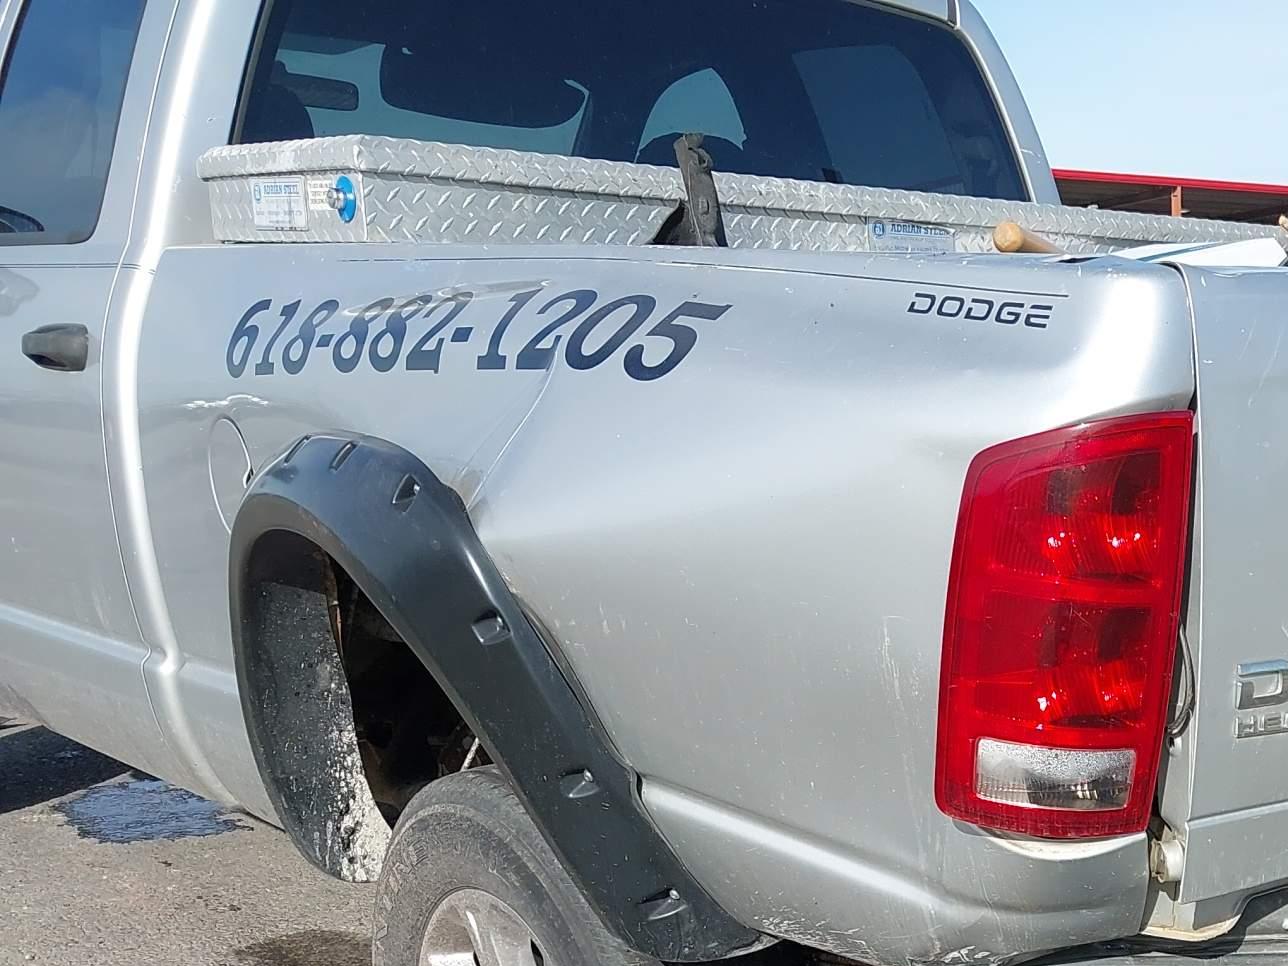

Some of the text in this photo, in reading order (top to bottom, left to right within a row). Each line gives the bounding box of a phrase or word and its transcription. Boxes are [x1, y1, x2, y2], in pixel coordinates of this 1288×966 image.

[890, 223, 921, 235] ADRIAN
[907, 292, 1054, 329] DODGE
[226, 288, 734, 382] 618-882-1205
